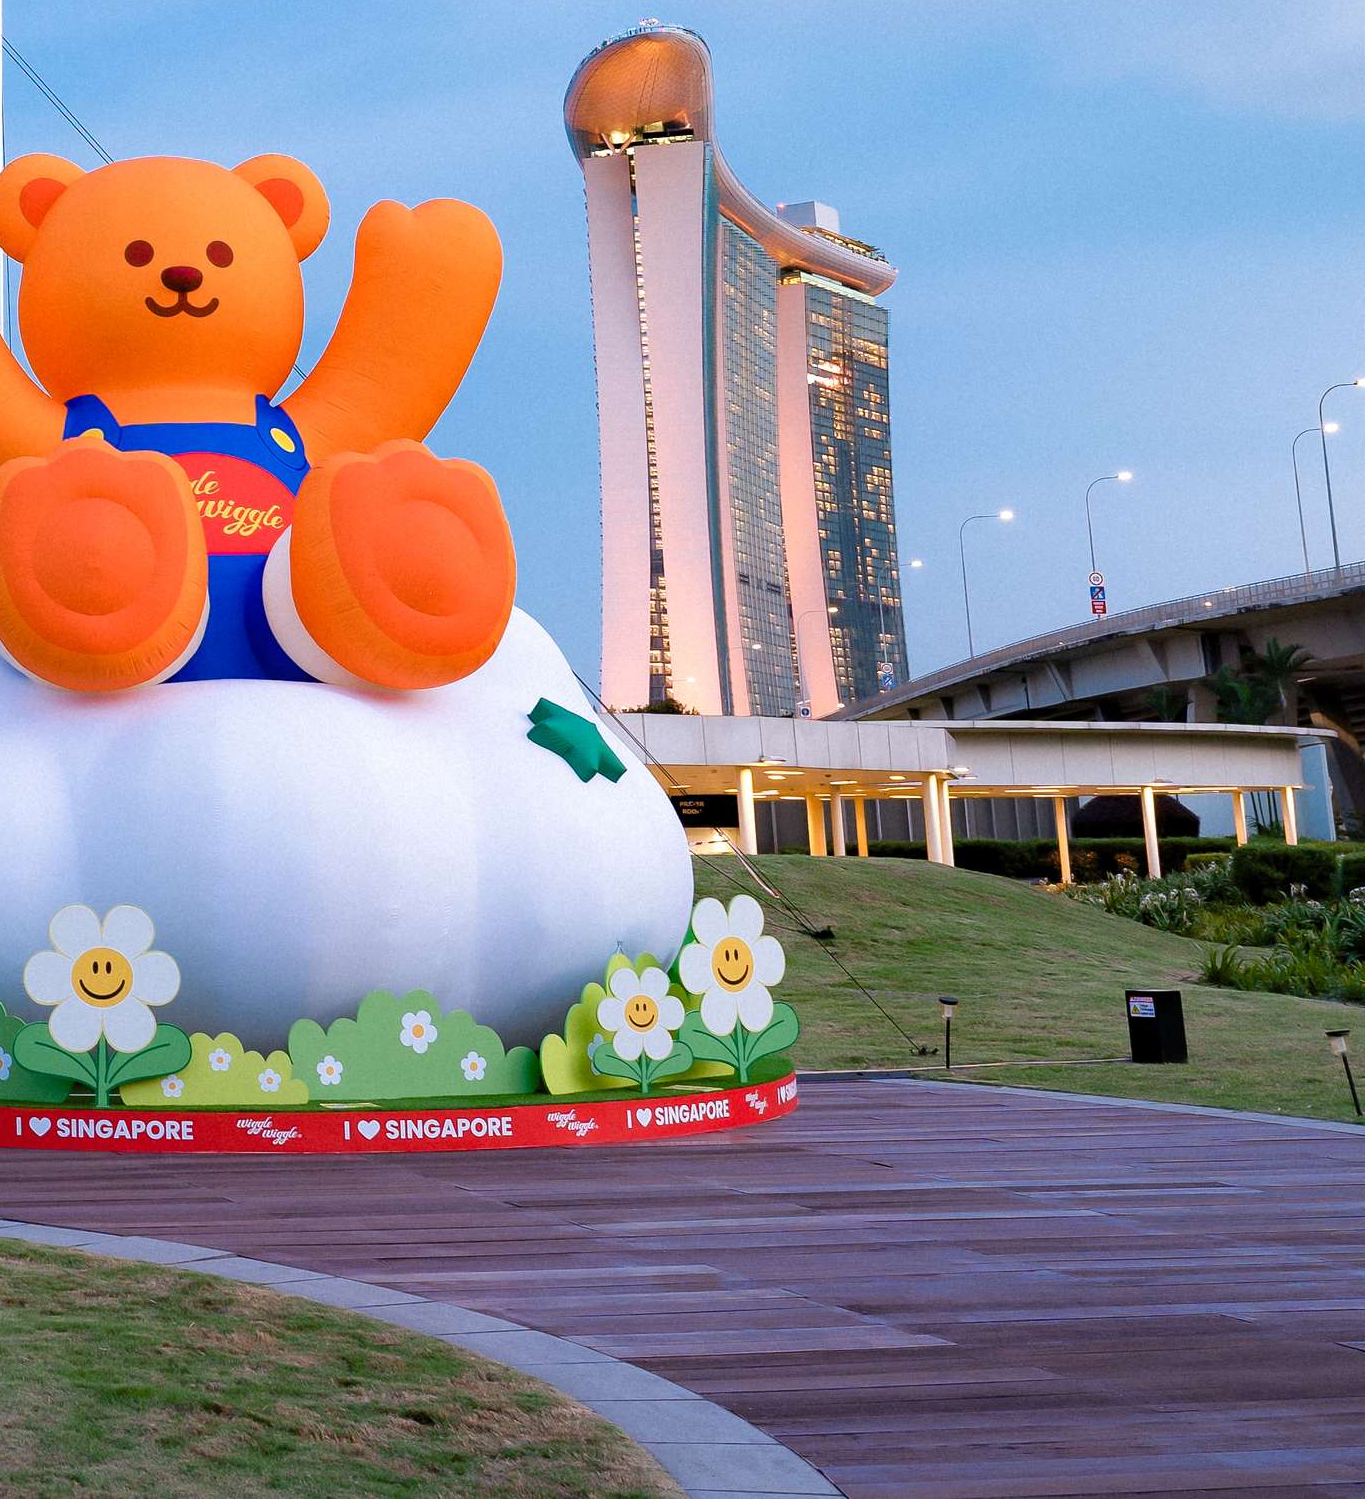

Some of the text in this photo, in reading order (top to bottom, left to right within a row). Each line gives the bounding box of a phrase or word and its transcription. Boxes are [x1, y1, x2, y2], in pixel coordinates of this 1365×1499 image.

[626, 1109, 633, 1129] I
[655, 1099, 730, 1126] SINGAPORE
[16, 1116, 194, 1140] I SINGAPORE
[343, 1116, 513, 1141] I SINGAPORE
